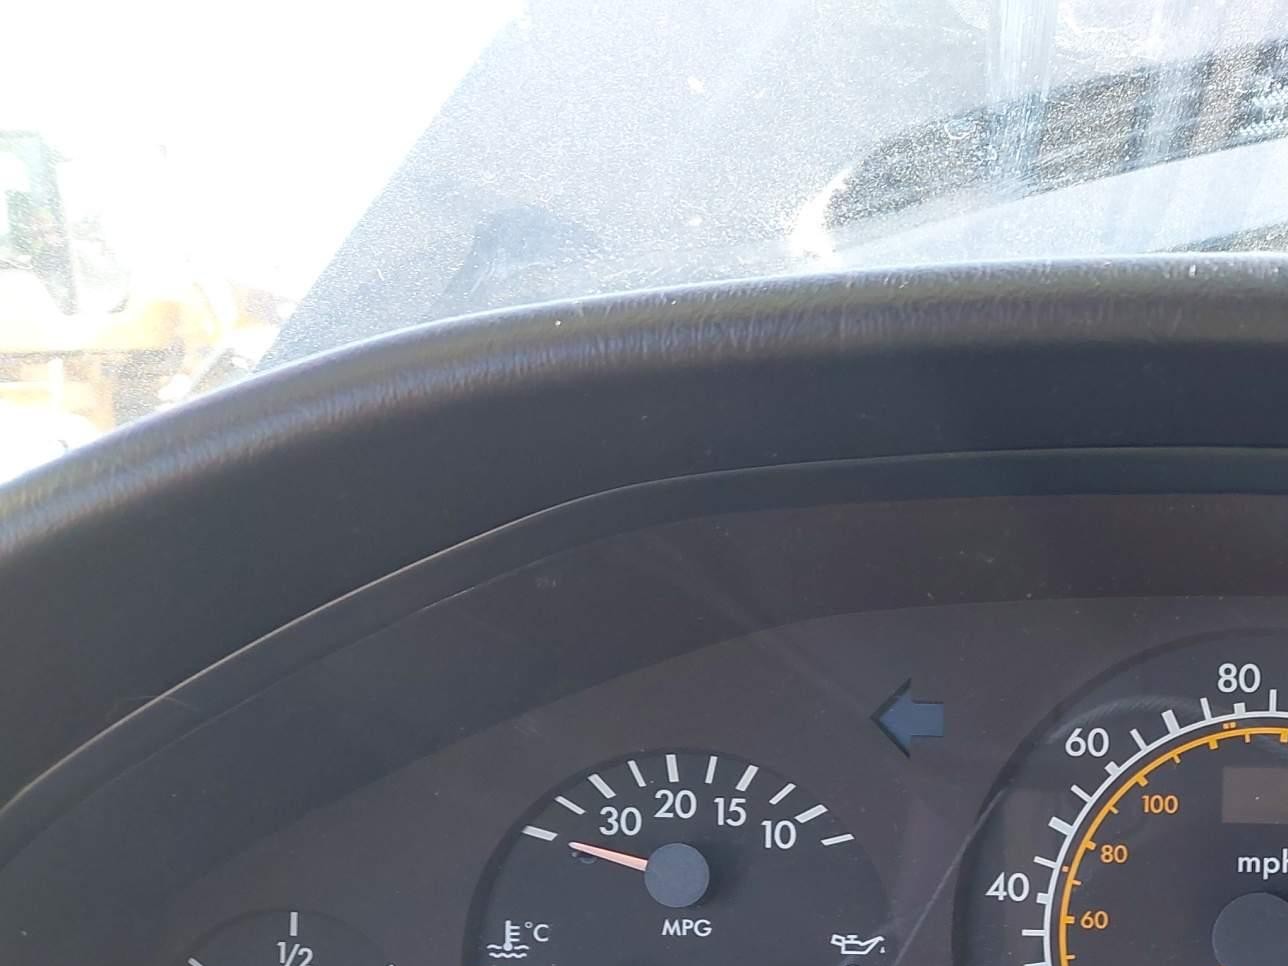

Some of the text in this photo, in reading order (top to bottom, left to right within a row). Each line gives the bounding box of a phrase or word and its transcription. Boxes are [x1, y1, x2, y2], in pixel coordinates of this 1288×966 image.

[1217, 663, 1261, 693] 80
[1065, 727, 1110, 757] 60
[654, 790, 696, 819] 20
[714, 798, 746, 827] 15
[1142, 795, 1179, 814] 100
[599, 806, 642, 837] 30
[761, 820, 796, 849] 10
[1100, 845, 1128, 864] 80
[985, 872, 1030, 901] 40
[661, 919, 712, 937] MPG
[1080, 910, 1109, 929] 60
